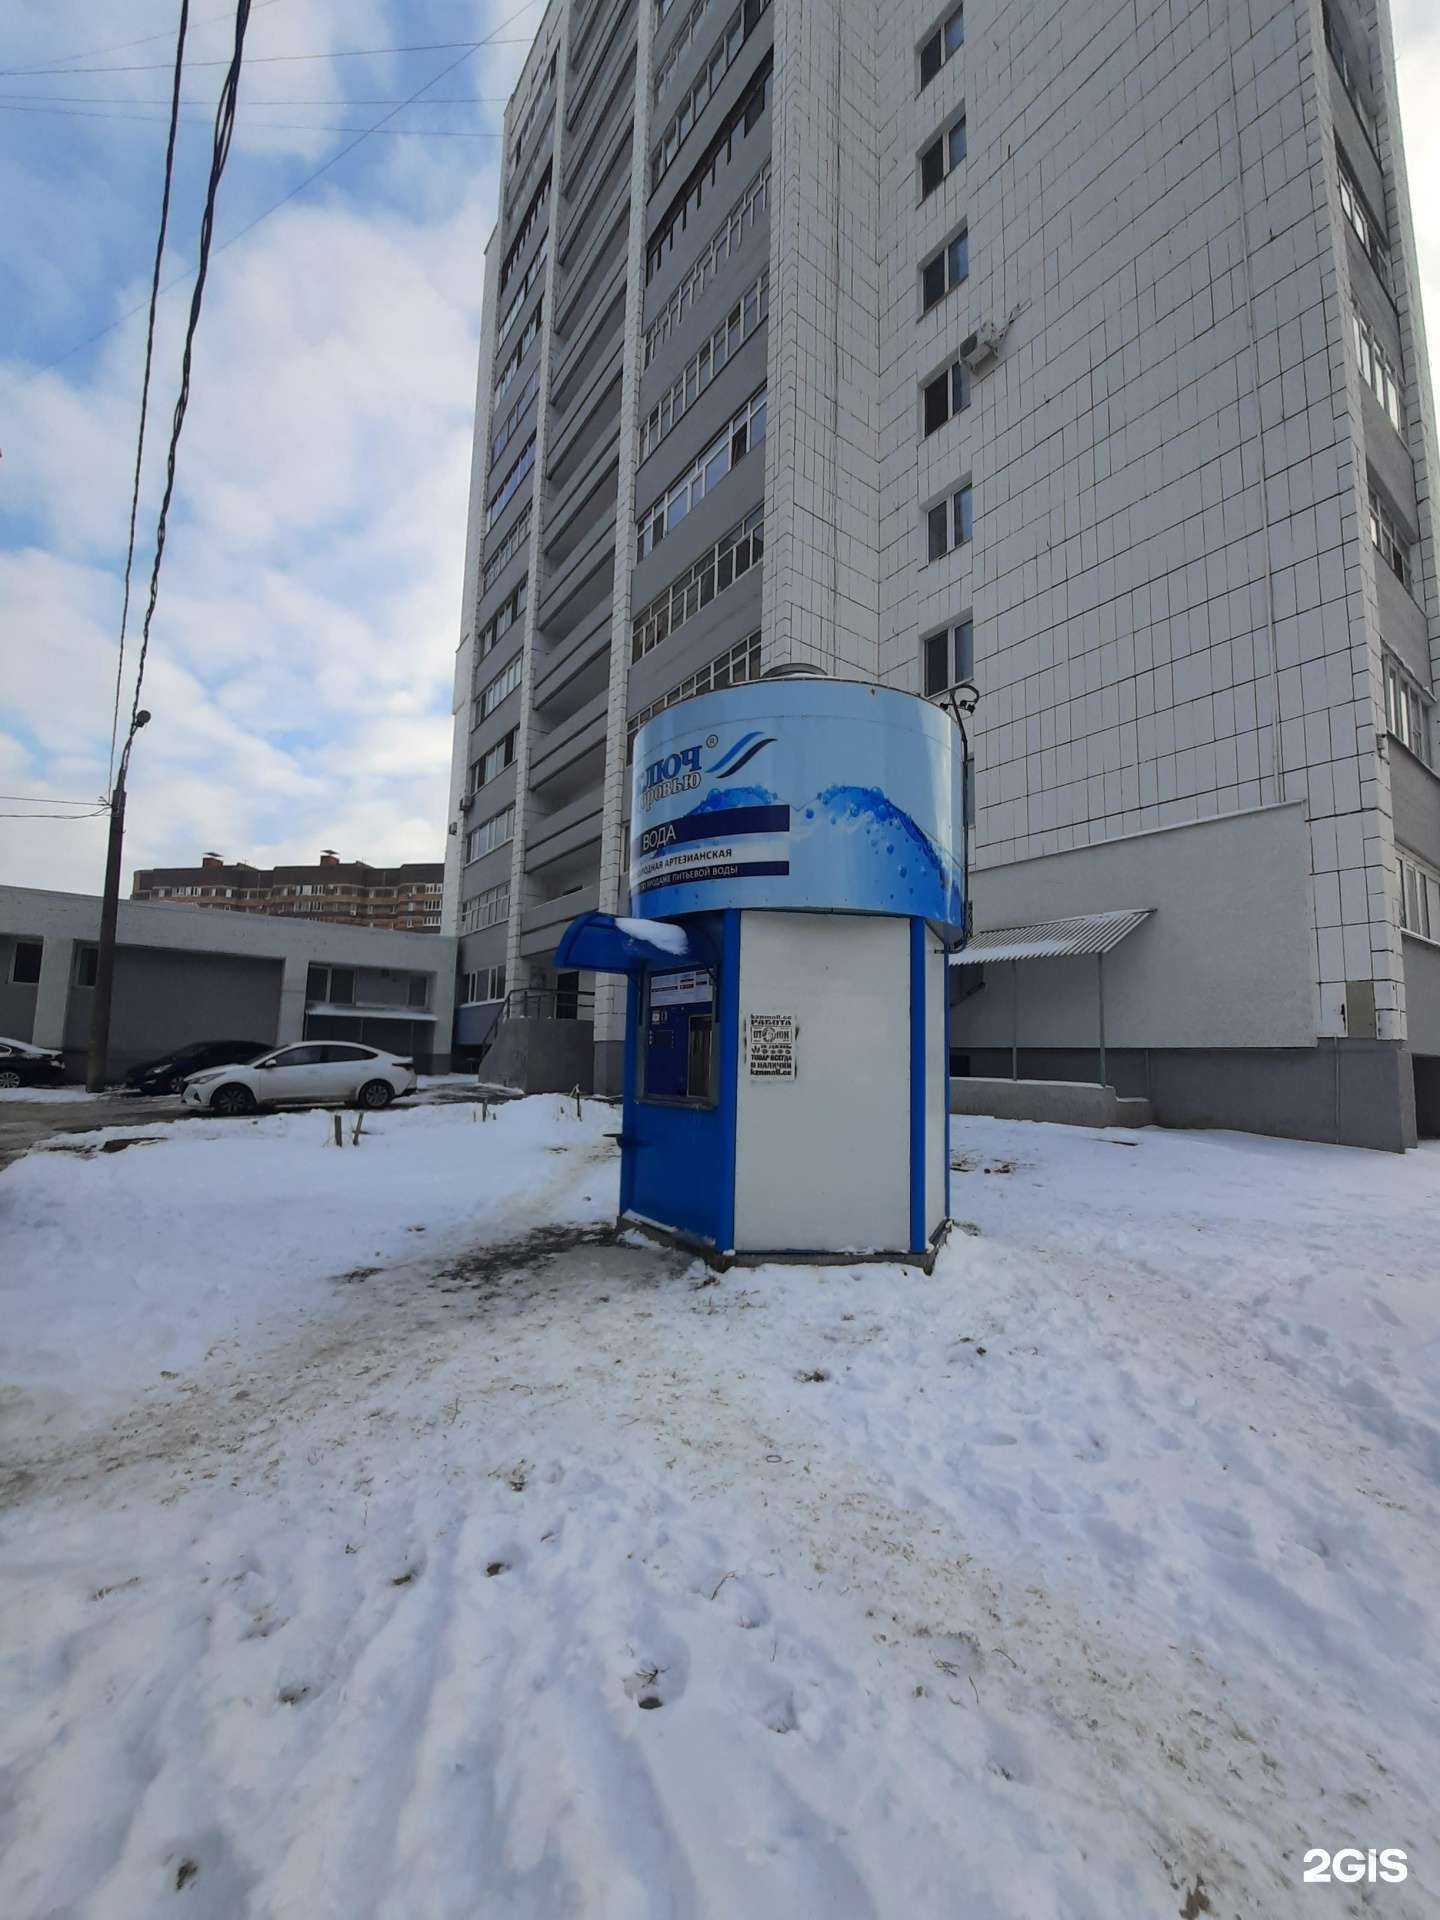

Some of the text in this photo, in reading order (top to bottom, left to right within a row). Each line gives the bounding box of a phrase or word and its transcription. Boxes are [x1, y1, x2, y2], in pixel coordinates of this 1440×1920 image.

[642, 825, 677, 851] ВОДА
[664, 848, 732, 867] АРТЕЗИАНСКАЯ
[672, 867, 711, 881] ПИТЬЕВОЙ
[712, 866, 738, 876] ВОДЫ
